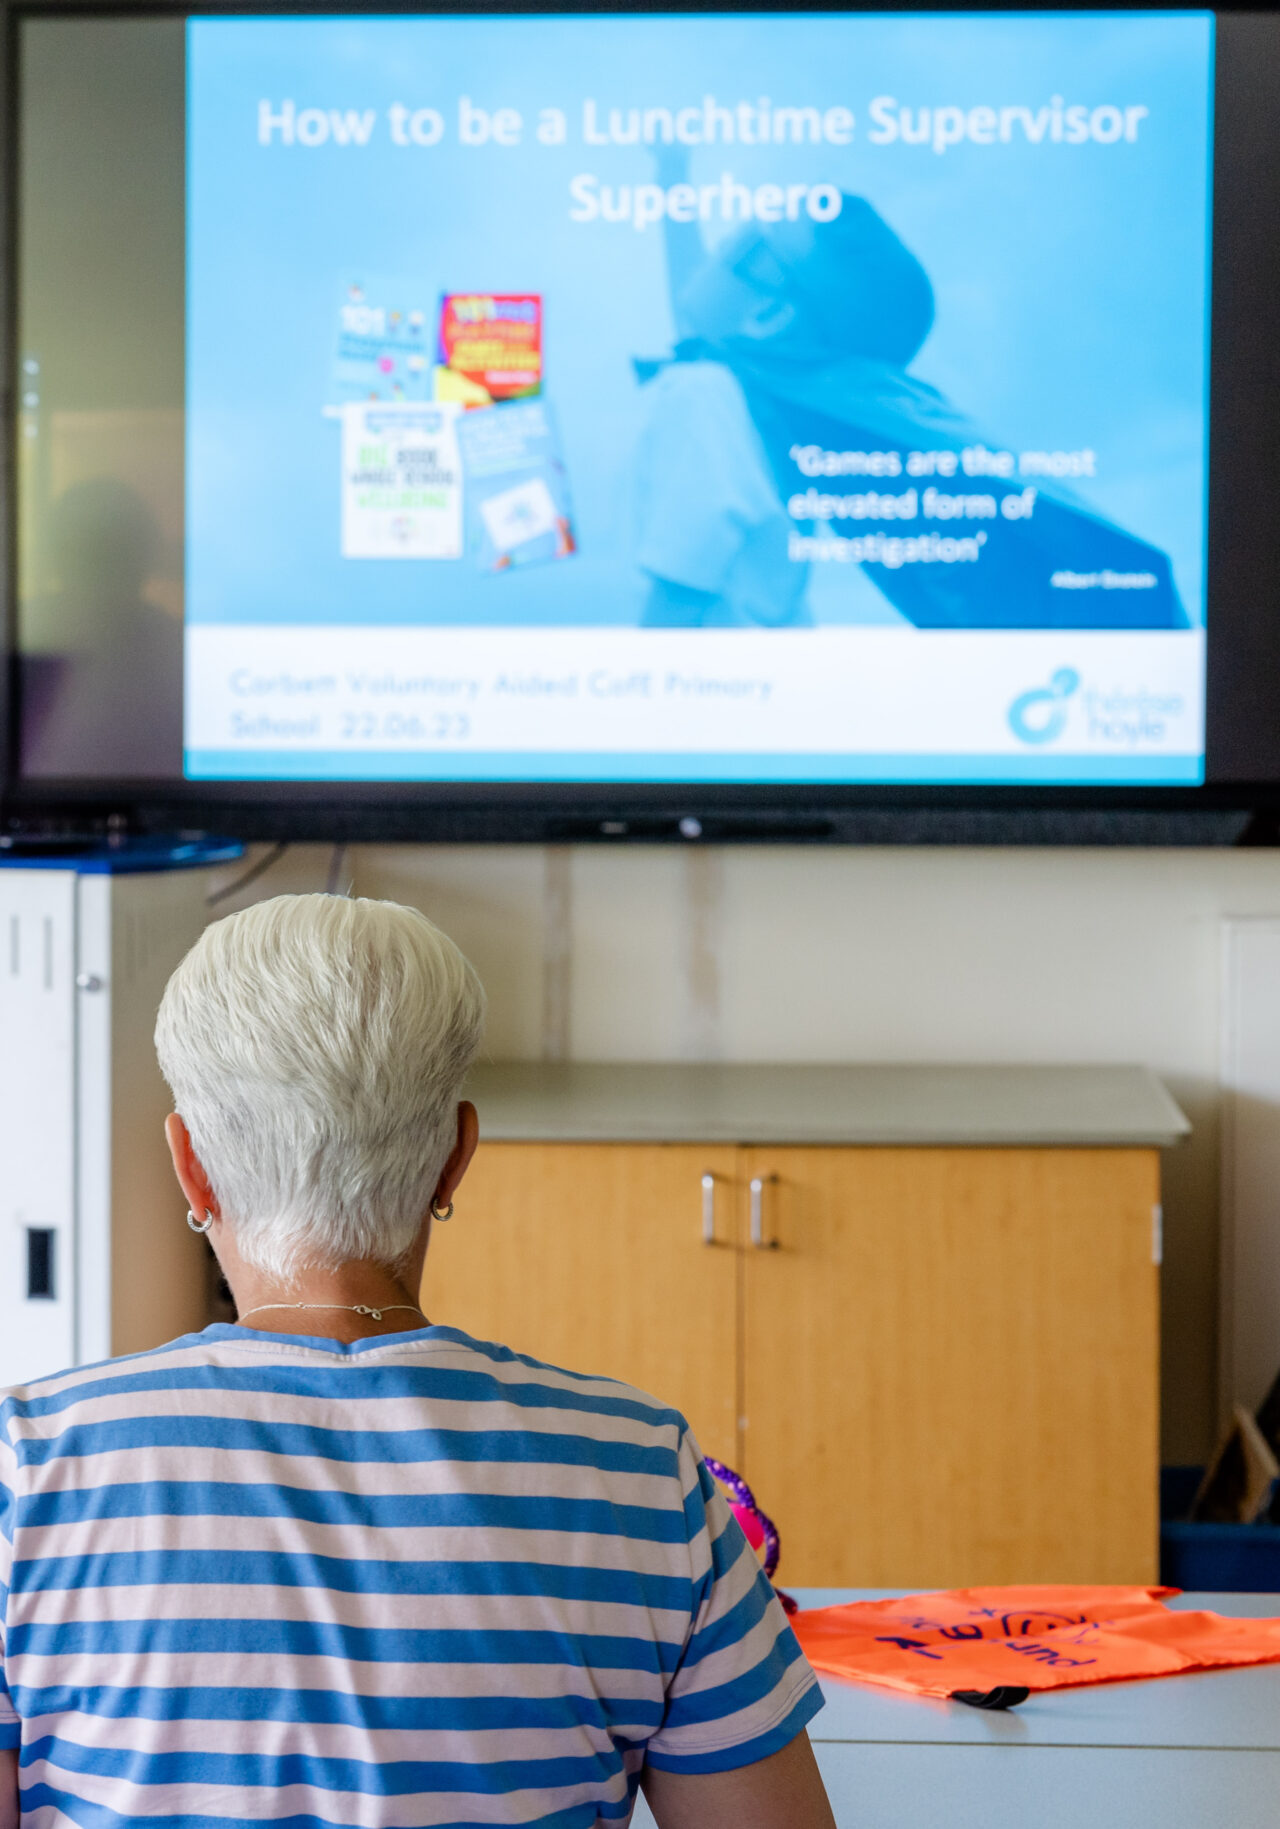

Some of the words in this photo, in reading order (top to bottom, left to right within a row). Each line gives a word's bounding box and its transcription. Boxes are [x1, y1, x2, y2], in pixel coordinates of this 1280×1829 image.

[258, 98, 376, 147] How
[389, 102, 444, 147] to
[459, 95, 522, 146] be
[536, 107, 567, 146] a
[583, 94, 855, 146] Lunchtime
[868, 94, 1148, 155] Supervisor
[569, 171, 843, 232] Superhero
[906, 450, 958, 478] are
[961, 444, 1015, 478] the
[1019, 447, 1096, 478] most
[788, 486, 918, 520] elevated
[923, 486, 997, 519] form
[1001, 486, 1036, 520] of
[346, 671, 479, 702] Voluntary
[494, 671, 578, 698] Aided
[665, 671, 774, 703] Primary
[230, 709, 320, 739] School
